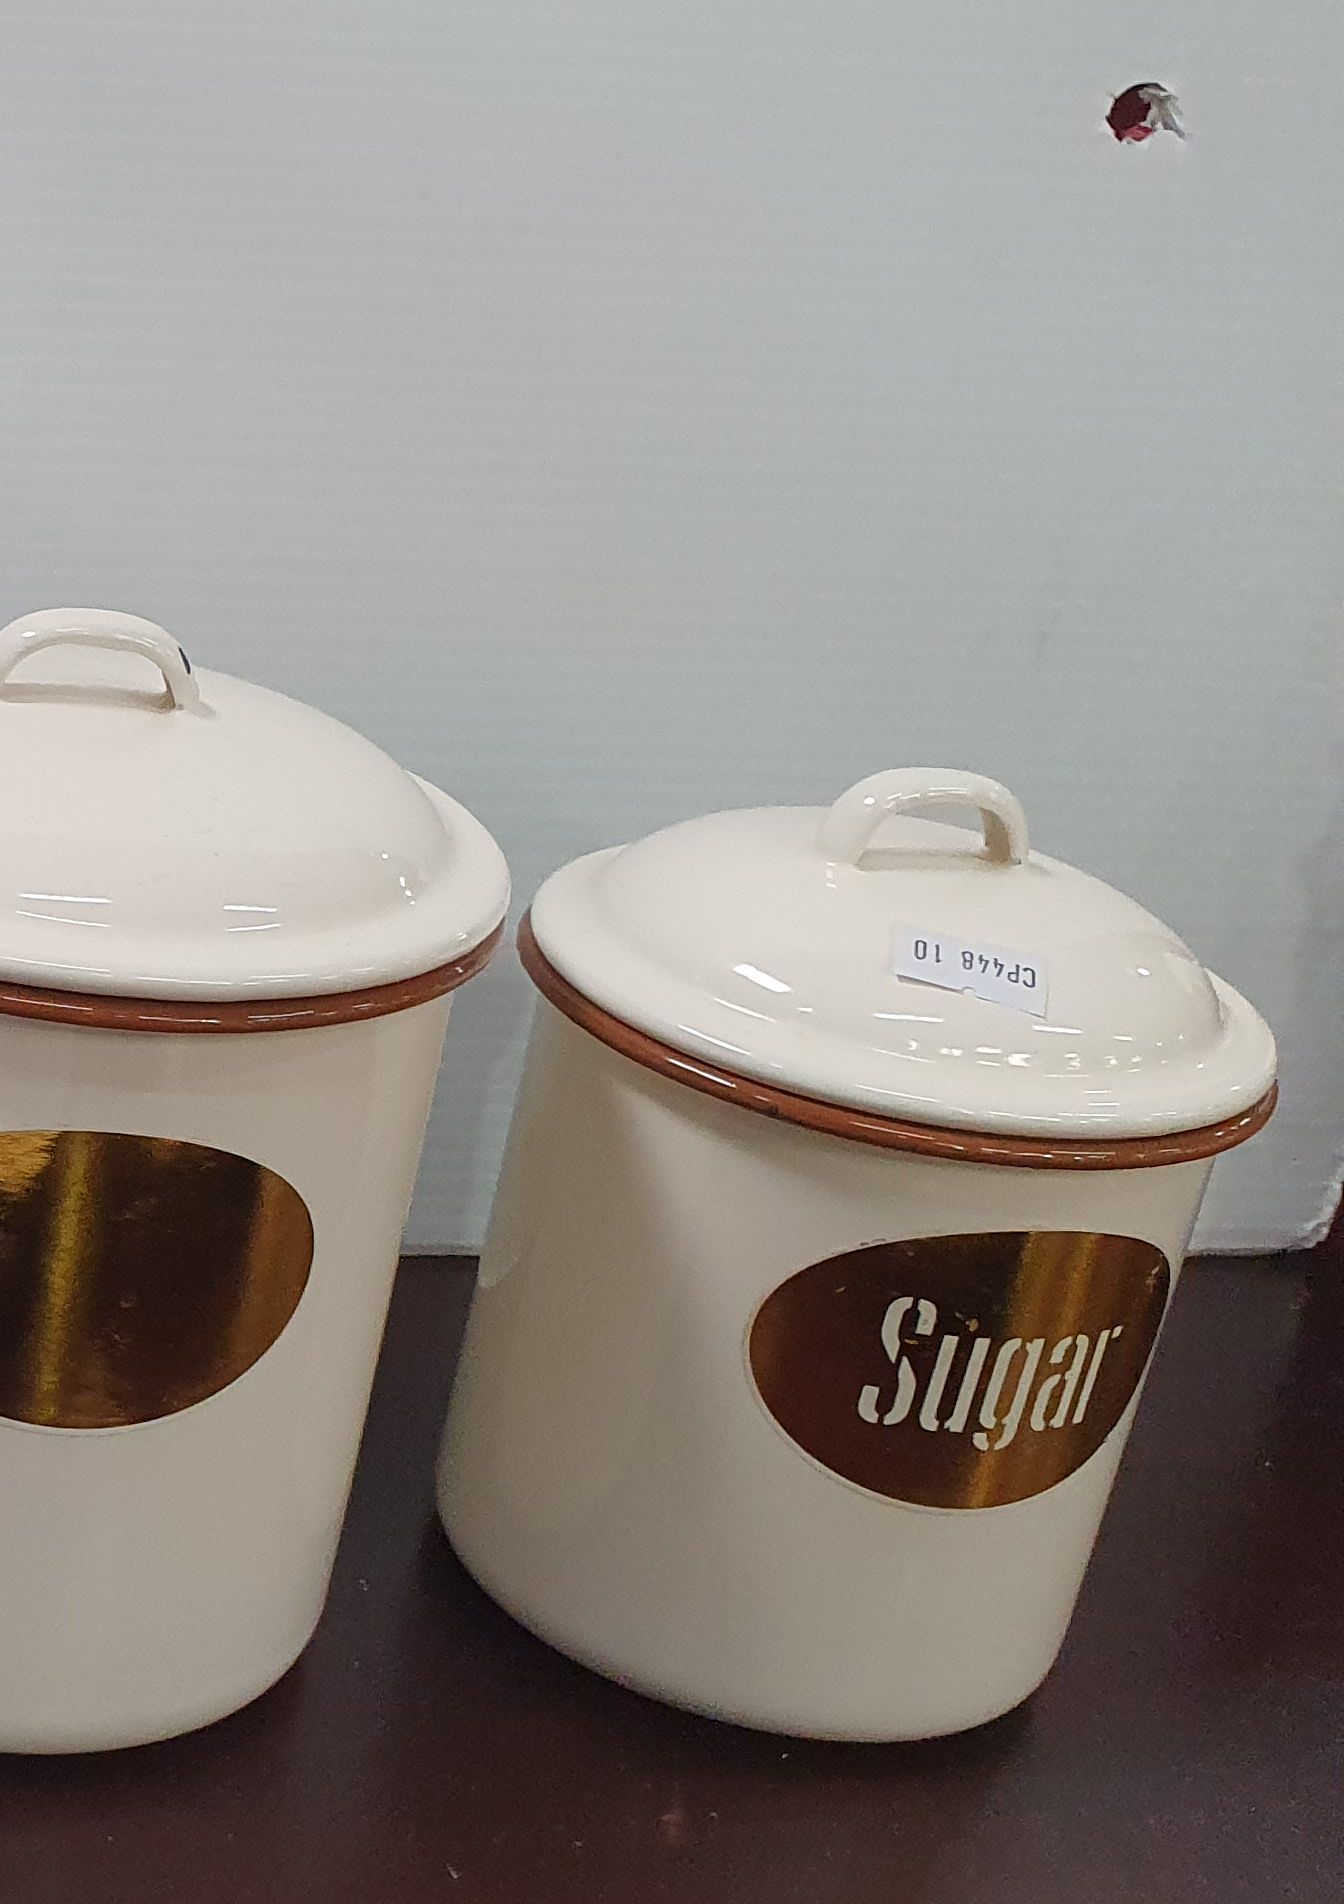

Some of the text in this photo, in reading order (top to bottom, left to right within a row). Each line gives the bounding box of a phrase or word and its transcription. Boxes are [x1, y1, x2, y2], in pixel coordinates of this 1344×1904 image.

[914, 939, 1037, 988] CP448 10
[857, 1296, 1123, 1451] Sugar
